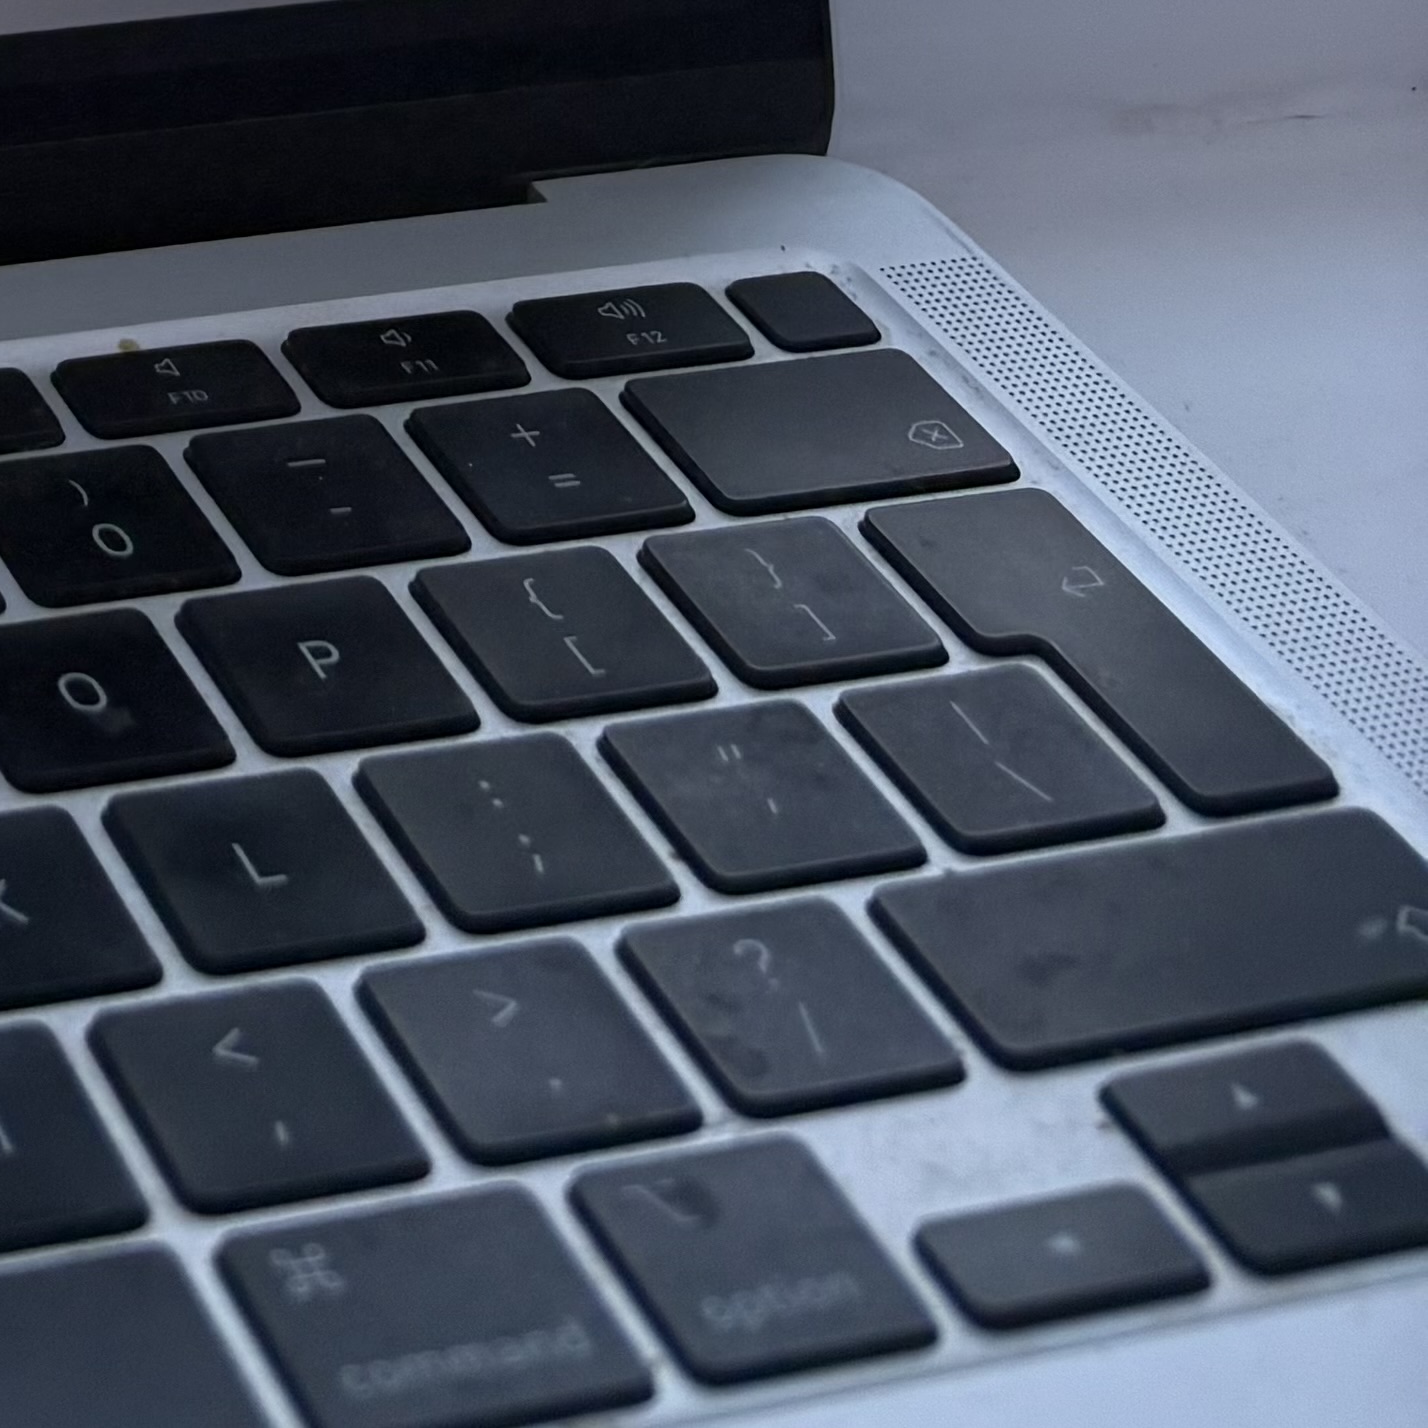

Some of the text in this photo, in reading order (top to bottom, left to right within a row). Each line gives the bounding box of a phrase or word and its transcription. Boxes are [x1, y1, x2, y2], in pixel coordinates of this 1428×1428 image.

[626, 330, 668, 346] F12
[91, 523, 134, 558] 0
[297, 640, 340, 680] P
[57, 672, 109, 715] O
[231, 843, 288, 887] L
